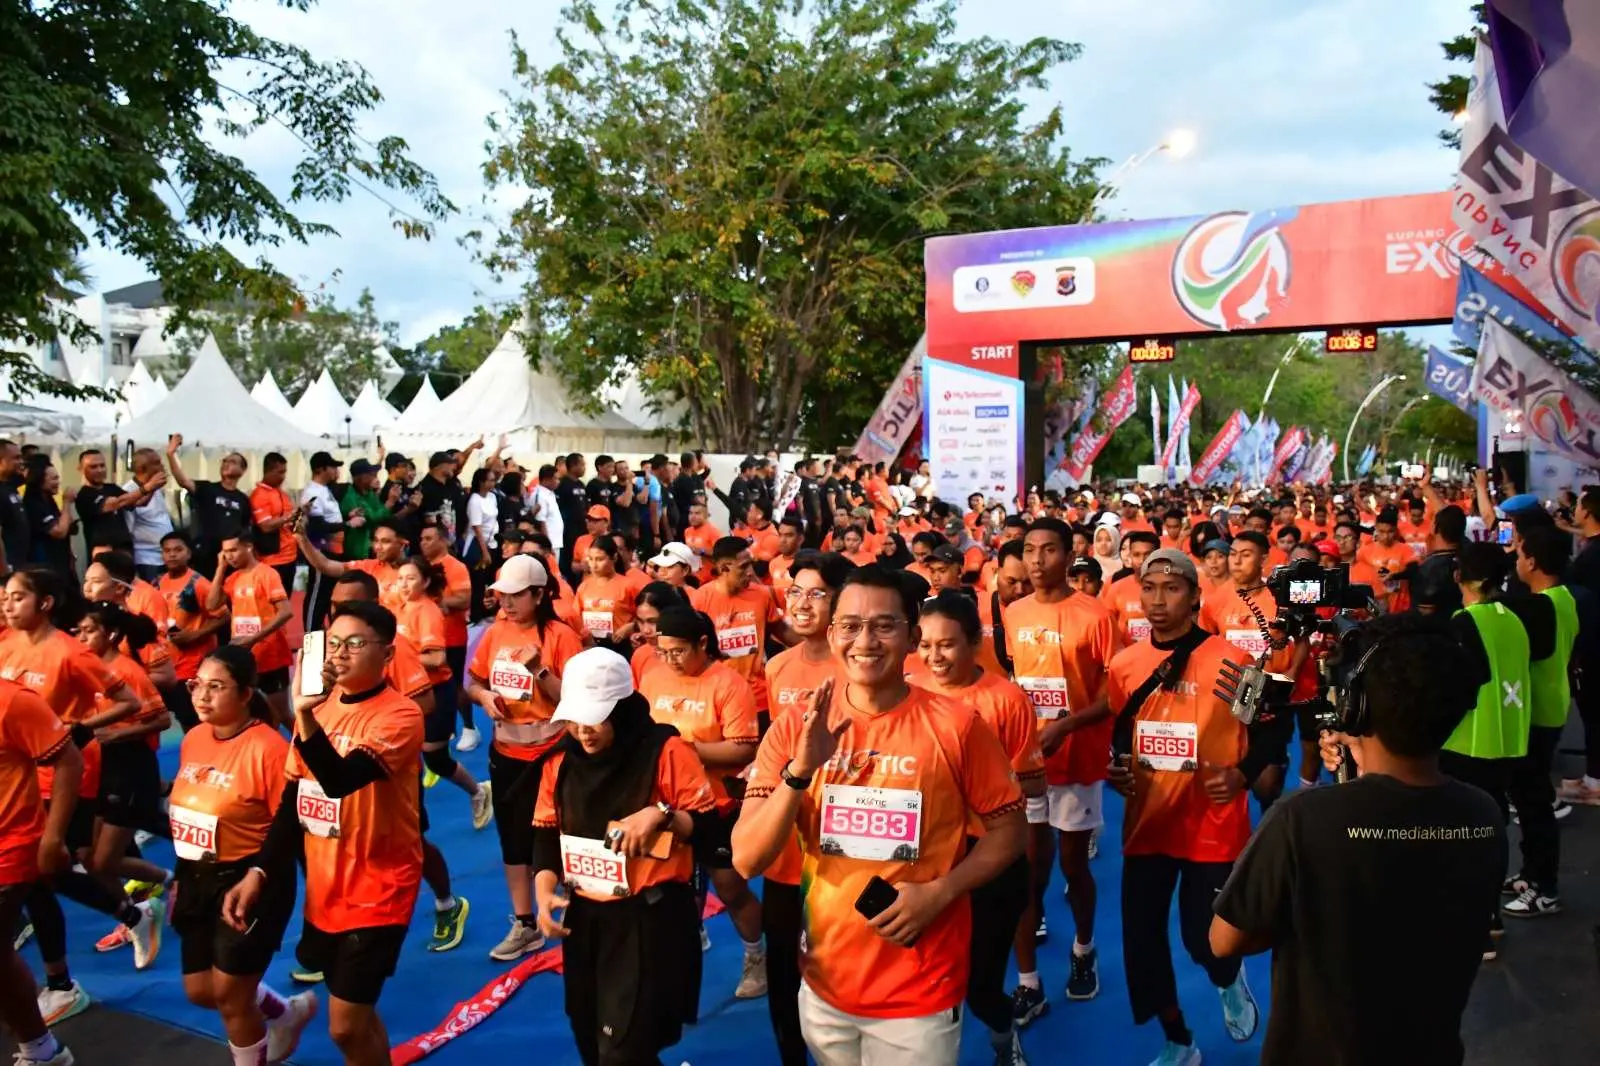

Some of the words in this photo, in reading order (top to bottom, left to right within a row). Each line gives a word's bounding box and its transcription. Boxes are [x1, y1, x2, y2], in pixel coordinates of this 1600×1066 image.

[1386, 229, 1446, 241] KUPANG
[971, 345, 1014, 360] START
[723, 637, 754, 651] 5114
[494, 672, 528, 689] 5527
[1143, 738, 1189, 756] 5669
[301, 797, 335, 821] 5736
[831, 808, 908, 838] 5983
[172, 821, 209, 847] 5710
[1347, 825, 1495, 840] www.mediakitantt.com
[568, 854, 618, 881] 5682
